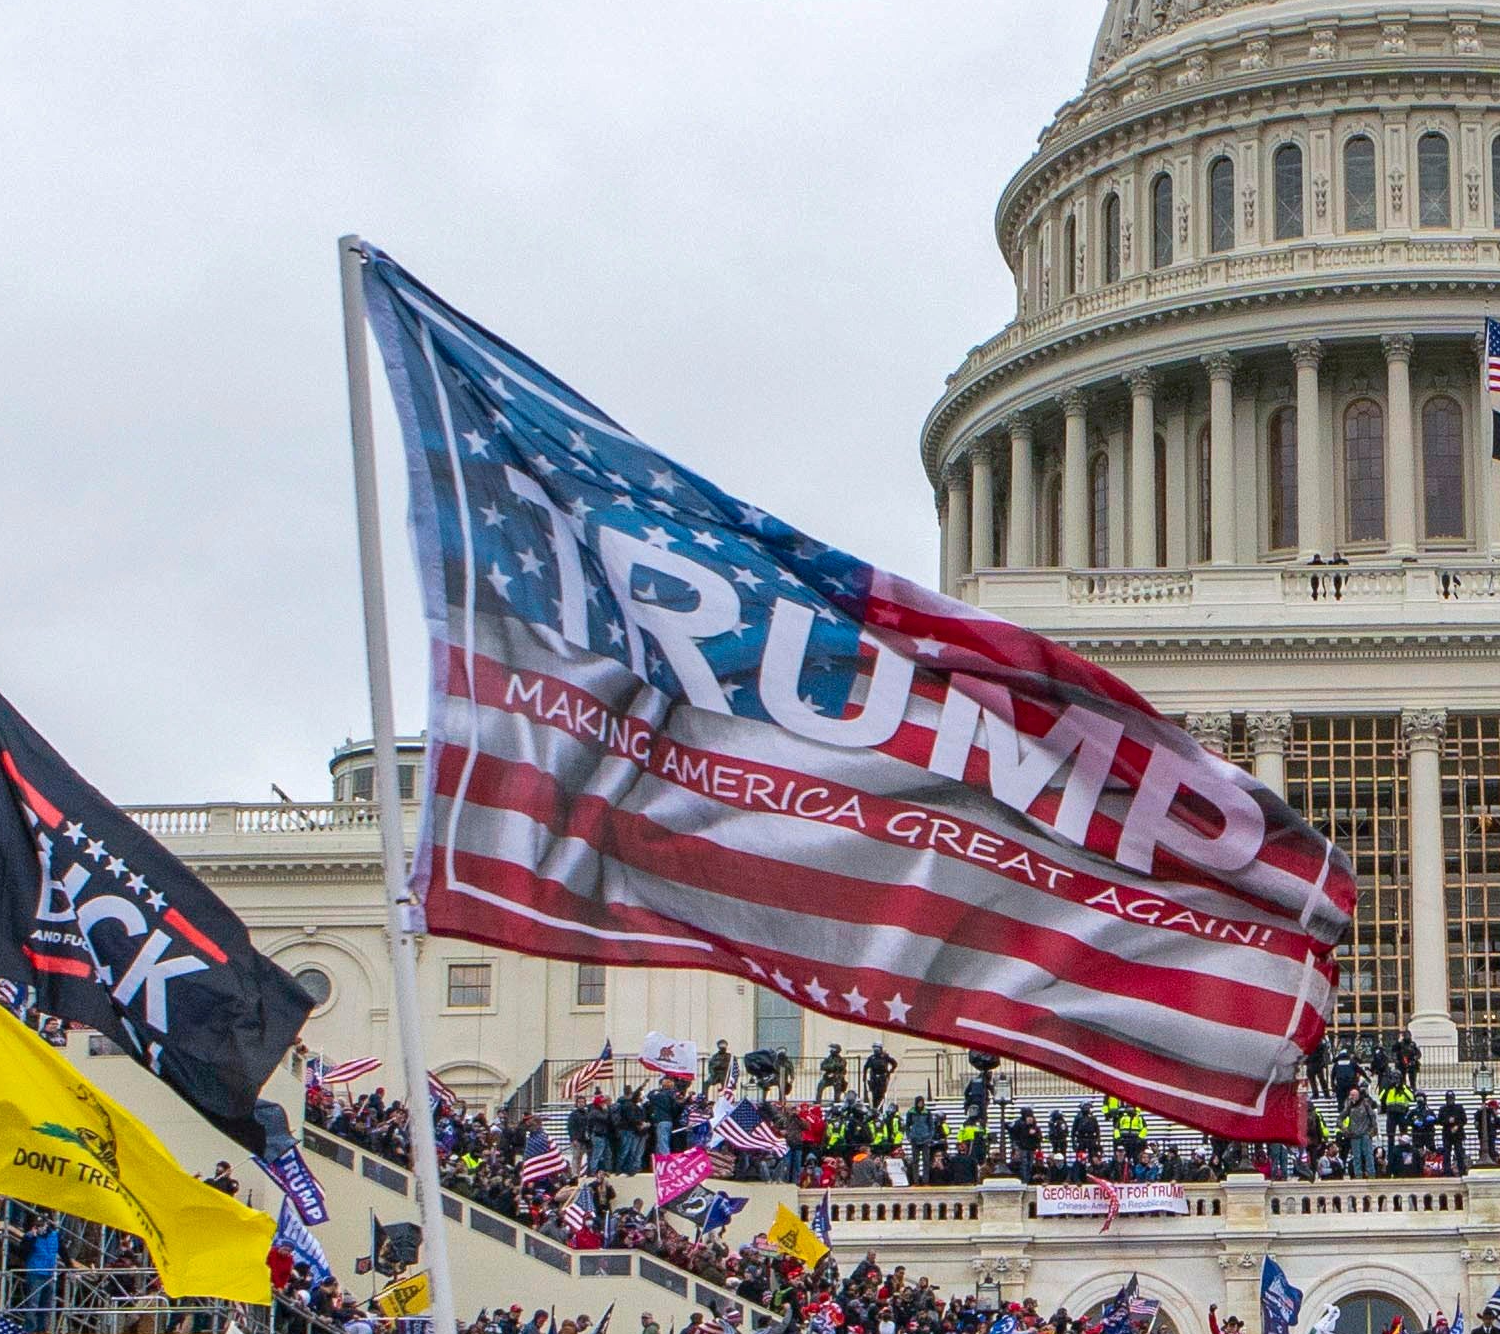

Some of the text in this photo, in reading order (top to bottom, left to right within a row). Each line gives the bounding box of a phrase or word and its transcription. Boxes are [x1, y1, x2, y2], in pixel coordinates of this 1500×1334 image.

[504, 466, 1267, 877] TRUMP
[506, 670, 1272, 948] MAKING AMERICA GREAT AGAIN!
[30, 930, 61, 944] AND
[13, 1147, 71, 1178] DONT
[282, 1149, 323, 1221] TRUMP
[1042, 1187, 1090, 1201] GEORGIA
[1093, 1187, 1123, 1201] FIGT
[1127, 1187, 1149, 1200] FOR
